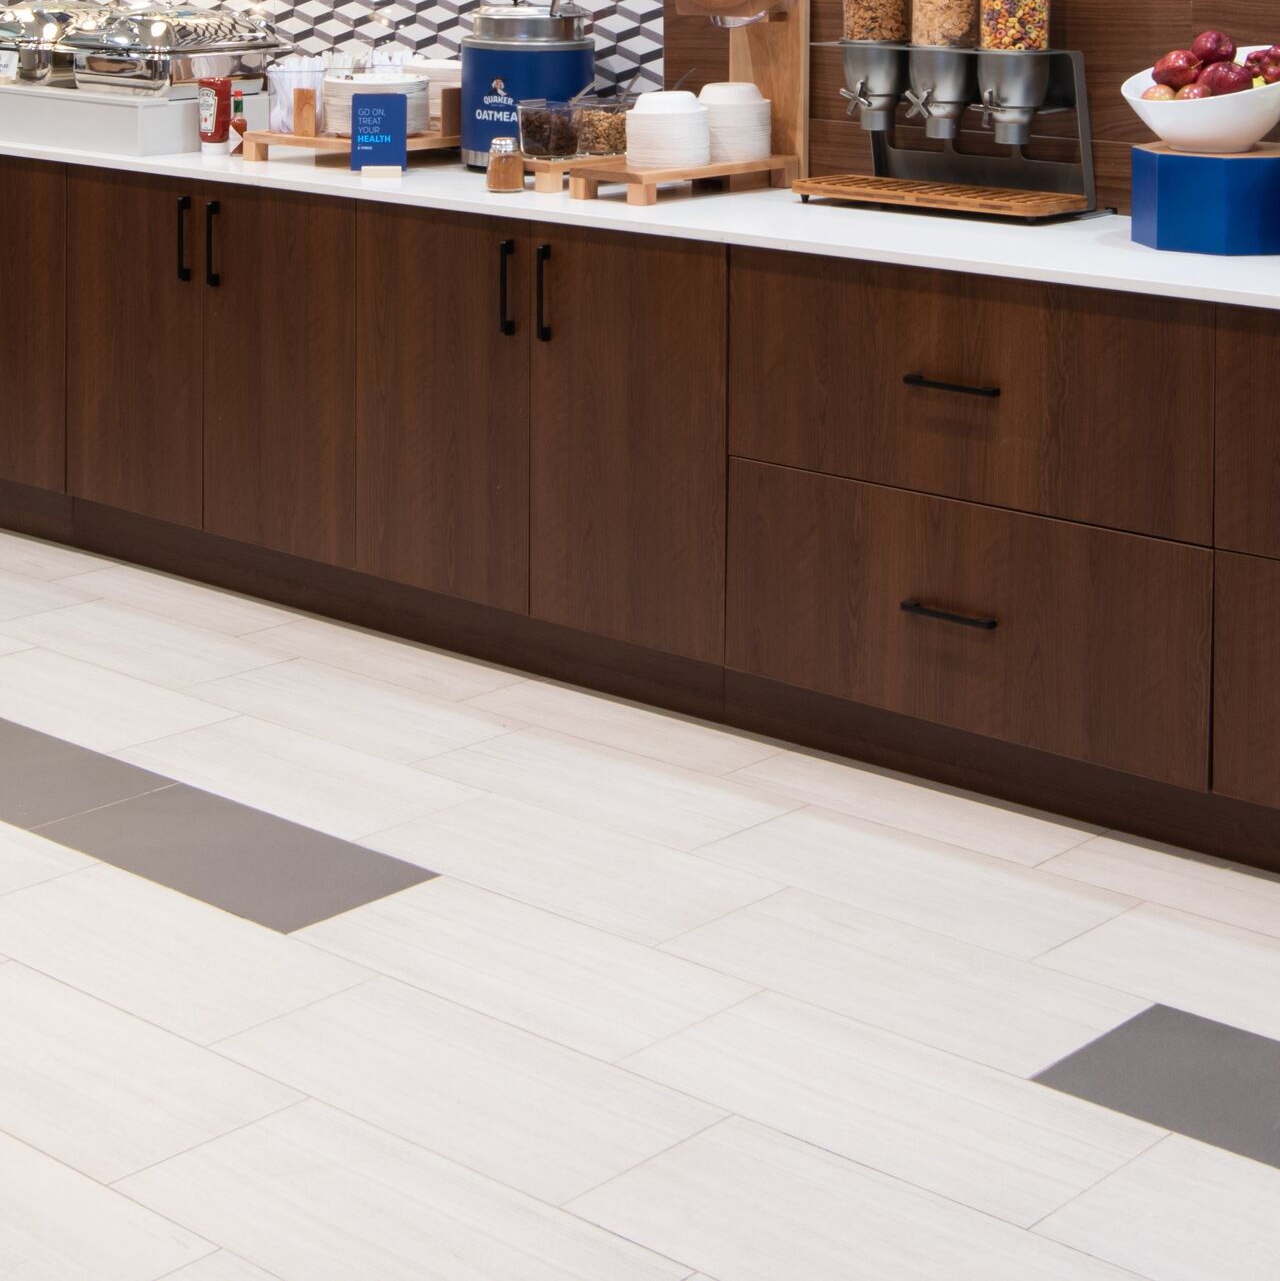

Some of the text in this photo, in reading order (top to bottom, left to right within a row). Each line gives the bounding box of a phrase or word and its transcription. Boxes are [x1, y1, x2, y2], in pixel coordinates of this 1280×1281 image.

[483, 95, 514, 105] QUAKER
[358, 108, 386, 117] GO ON,
[475, 109, 518, 122] OATMEA
[358, 117, 381, 125] TREAT
[357, 126, 381, 134] YOUR
[357, 134, 391, 143] HEALTH
